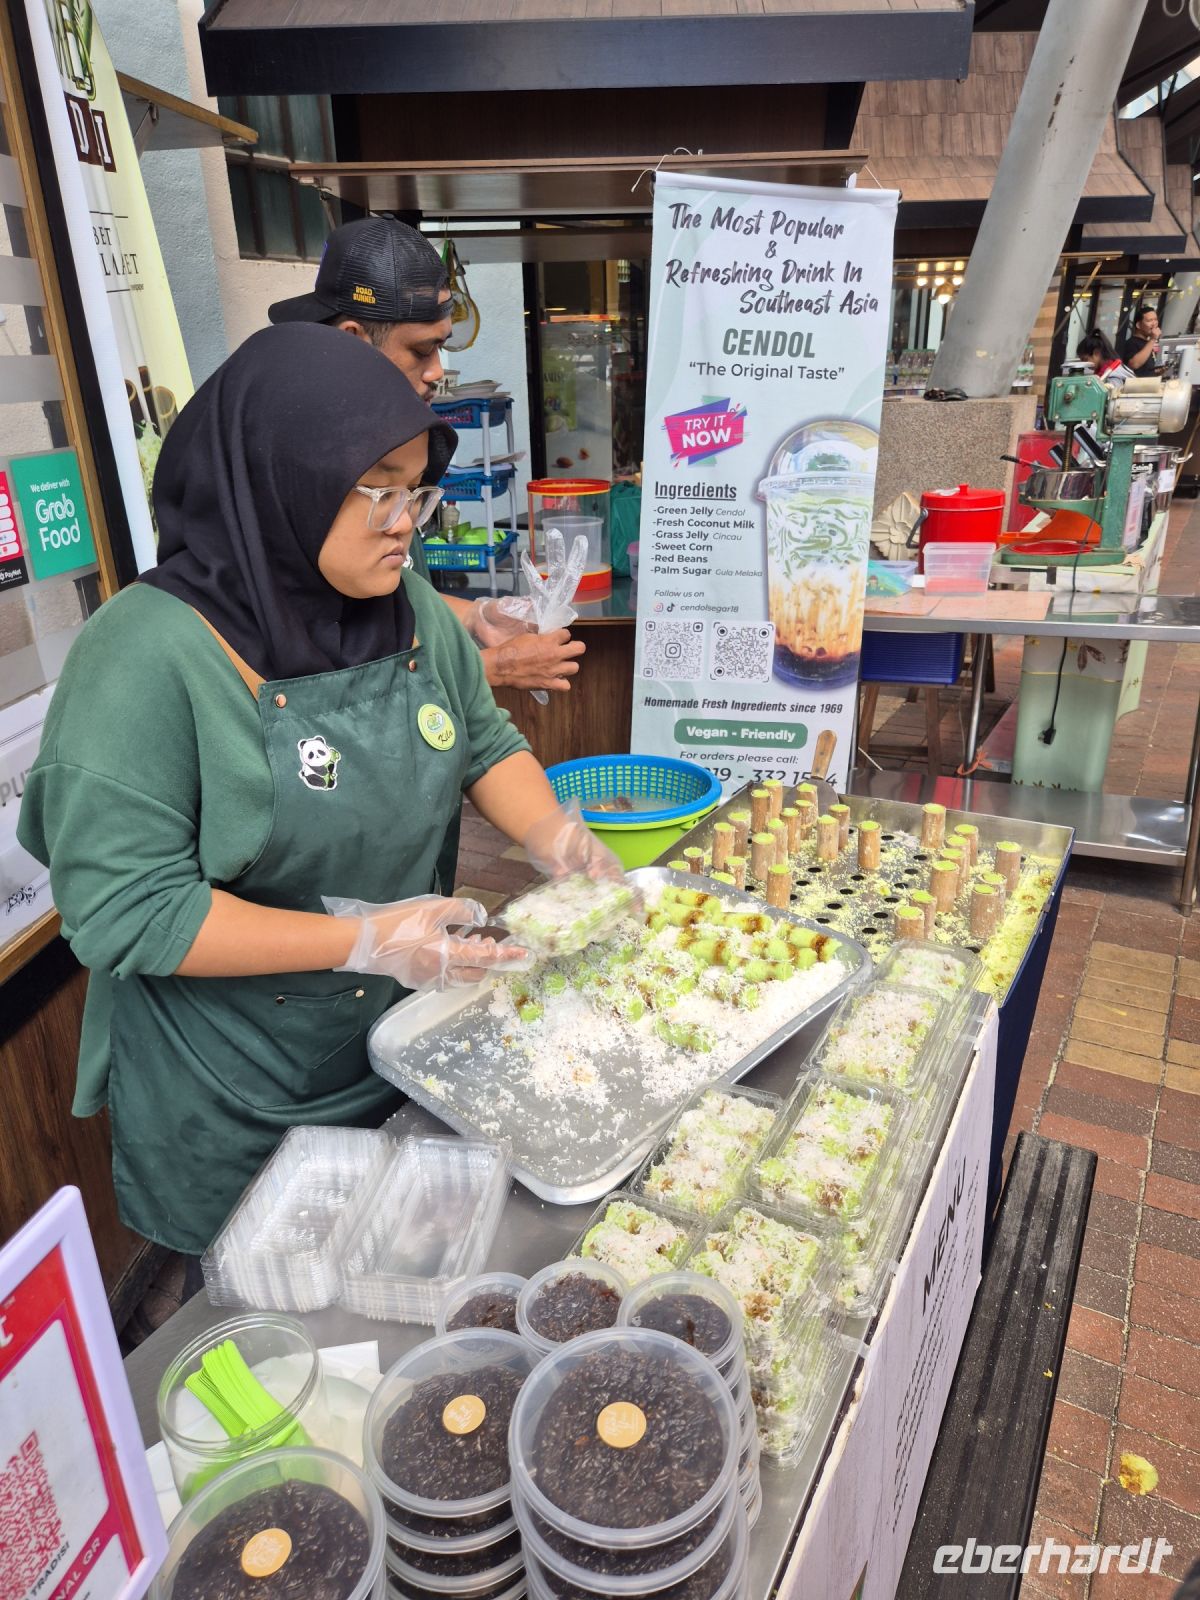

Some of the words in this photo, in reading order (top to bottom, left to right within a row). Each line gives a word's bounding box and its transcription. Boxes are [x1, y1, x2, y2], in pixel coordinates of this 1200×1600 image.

[668, 202, 701, 230] The
[711, 206, 765, 235] Most
[769, 211, 844, 244] Popular
[764, 240, 777, 258] &
[665, 259, 774, 291] Refreshing
[781, 260, 835, 284] Drink
[843, 261, 863, 283] In
[352, 293, 376, 304] RUNNER
[355, 286, 373, 296] ROAD
[740, 290, 835, 315] Southeast
[840, 290, 879, 315] Asia
[722, 328, 816, 358] CENDOL
[731, 363, 793, 381] Original
[685, 416, 711, 431] TRY
[713, 415, 727, 428] IT
[681, 428, 731, 449] NOW
[30, 483, 41, 492] We
[40, 480, 59, 491] deliver
[59, 479, 70, 488] with
[655, 481, 737, 500] Ingredients
[35, 493, 75, 523] Grab
[690, 506, 713, 517] Jelly
[715, 508, 745, 516] Cendol
[687, 519, 730, 528] Coconut
[733, 520, 755, 529] Milk
[39, 518, 80, 551] Food
[686, 531, 709, 541] Jelly
[713, 532, 742, 541] Cincau
[689, 543, 713, 551] Corn
[677, 554, 708, 563] Beans
[682, 566, 712, 576] Sugar
[644, 697, 698, 709] Homemade
[701, 698, 728, 709] Fresh
[731, 700, 786, 713] Ingredients
[789, 703, 816, 713] since
[820, 704, 843, 713] 1969
[686, 726, 728, 739] Vegan
[740, 728, 796, 743] Friendly
[680, 751, 698, 760] For
[700, 752, 734, 761] orders
[737, 754, 773, 763] please
[776, 755, 799, 764] call:
[793, 771, 838, 788] 154
[923, 1156, 966, 1317] MENU
[31, 1541, 69, 1596] TRADISI
